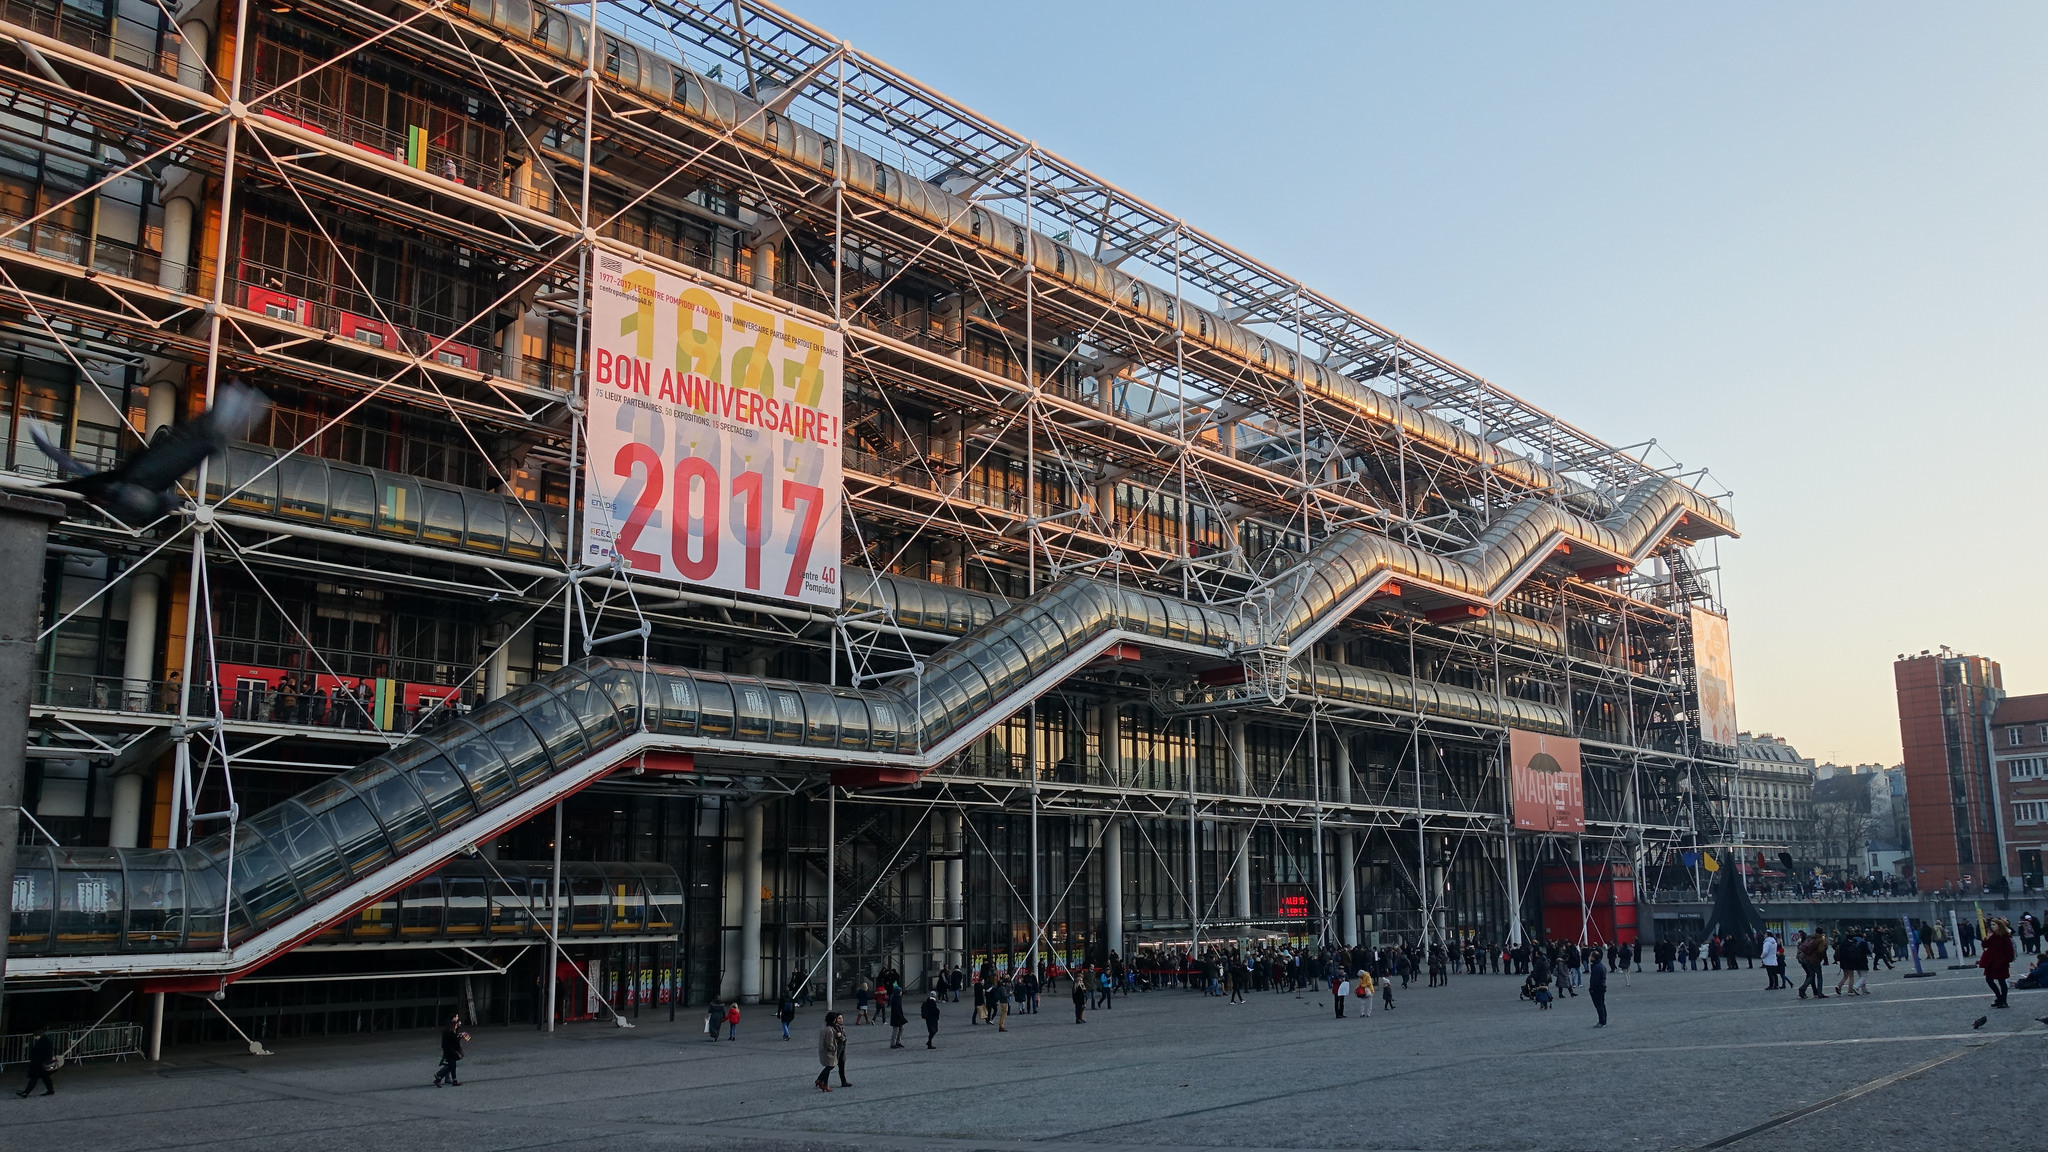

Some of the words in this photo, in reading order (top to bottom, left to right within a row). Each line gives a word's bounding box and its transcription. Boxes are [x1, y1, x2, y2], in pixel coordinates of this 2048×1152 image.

[599, 284, 653, 307] centrepompidou40.fr
[634, 283, 642, 294] LE
[642, 287, 665, 301] CENTRE
[665, 294, 695, 311] POMPIDOU
[700, 305, 709, 315] 40
[723, 314, 732, 324] UN
[732, 317, 770, 335] ANNIVERSAIRE
[770, 330, 791, 343] PARTAGÉ
[791, 336, 813, 350] PARTOUT
[813, 343, 820, 352] EN
[820, 345, 839, 358] FRANCE
[596, 347, 651, 396] BON
[595, 388, 604, 398] 75
[604, 391, 622, 403] LIEUX
[665, 407, 673, 416] 50
[712, 420, 719, 429] 15
[719, 422, 753, 438] SPECTACLES
[613, 442, 824, 598] 2017
[798, 568, 819, 581] Centre
[821, 566, 836, 584] 40
[805, 581, 836, 595] Pompidou
